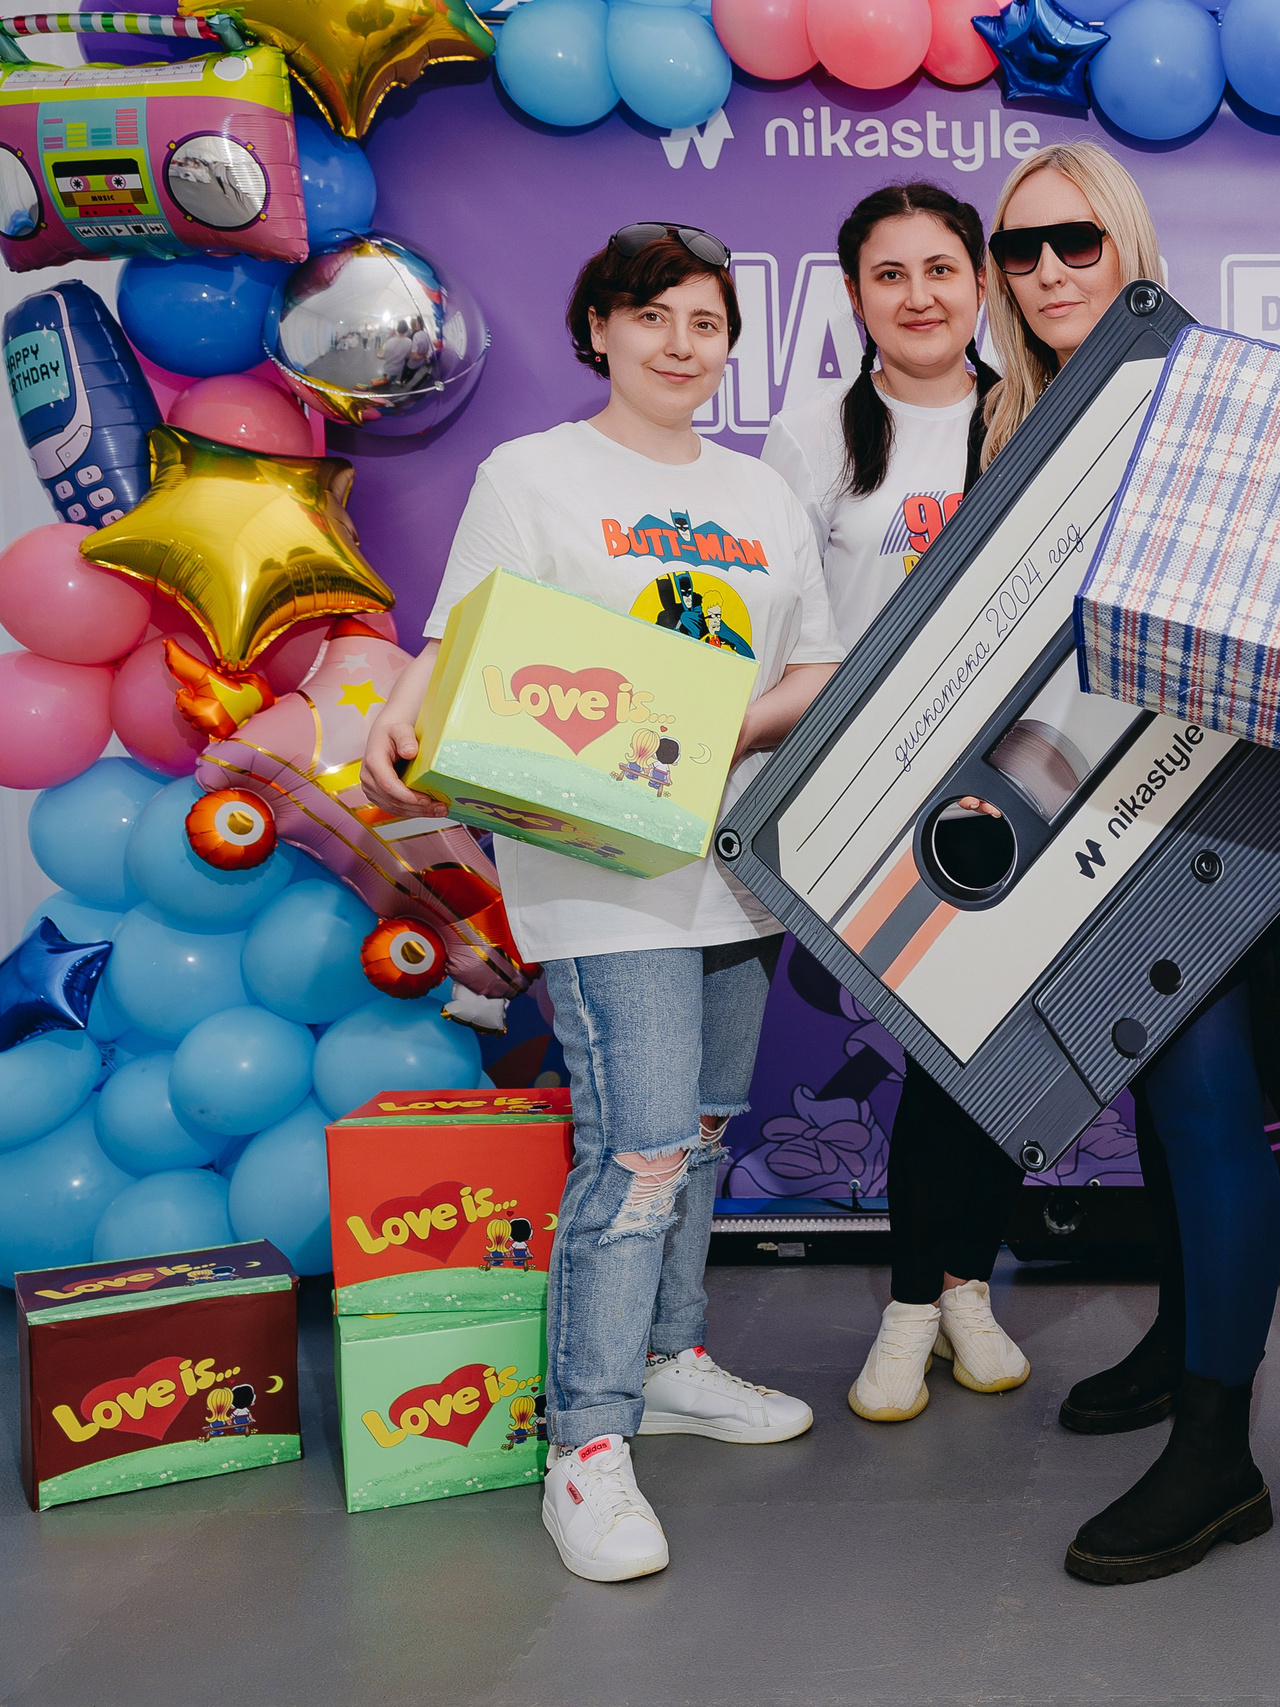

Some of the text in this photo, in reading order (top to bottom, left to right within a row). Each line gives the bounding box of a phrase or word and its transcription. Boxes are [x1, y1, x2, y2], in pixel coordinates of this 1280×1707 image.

[764, 106, 1041, 172] nikastyle
[91, 194, 115, 202] MUSIC
[601, 518, 769, 568] BUTT-MAN
[894, 522, 1085, 773] дискотека 2004 год
[481, 665, 610, 722] Love
[1107, 724, 1205, 840] nikastyle
[377, 1099, 488, 1112] Love
[346, 1203, 458, 1255] Love
[34, 1272, 155, 1300] Love
[51, 1379, 177, 1443] Love
[361, 1386, 481, 1448] Love
[581, 1442, 608, 1459] adidas
